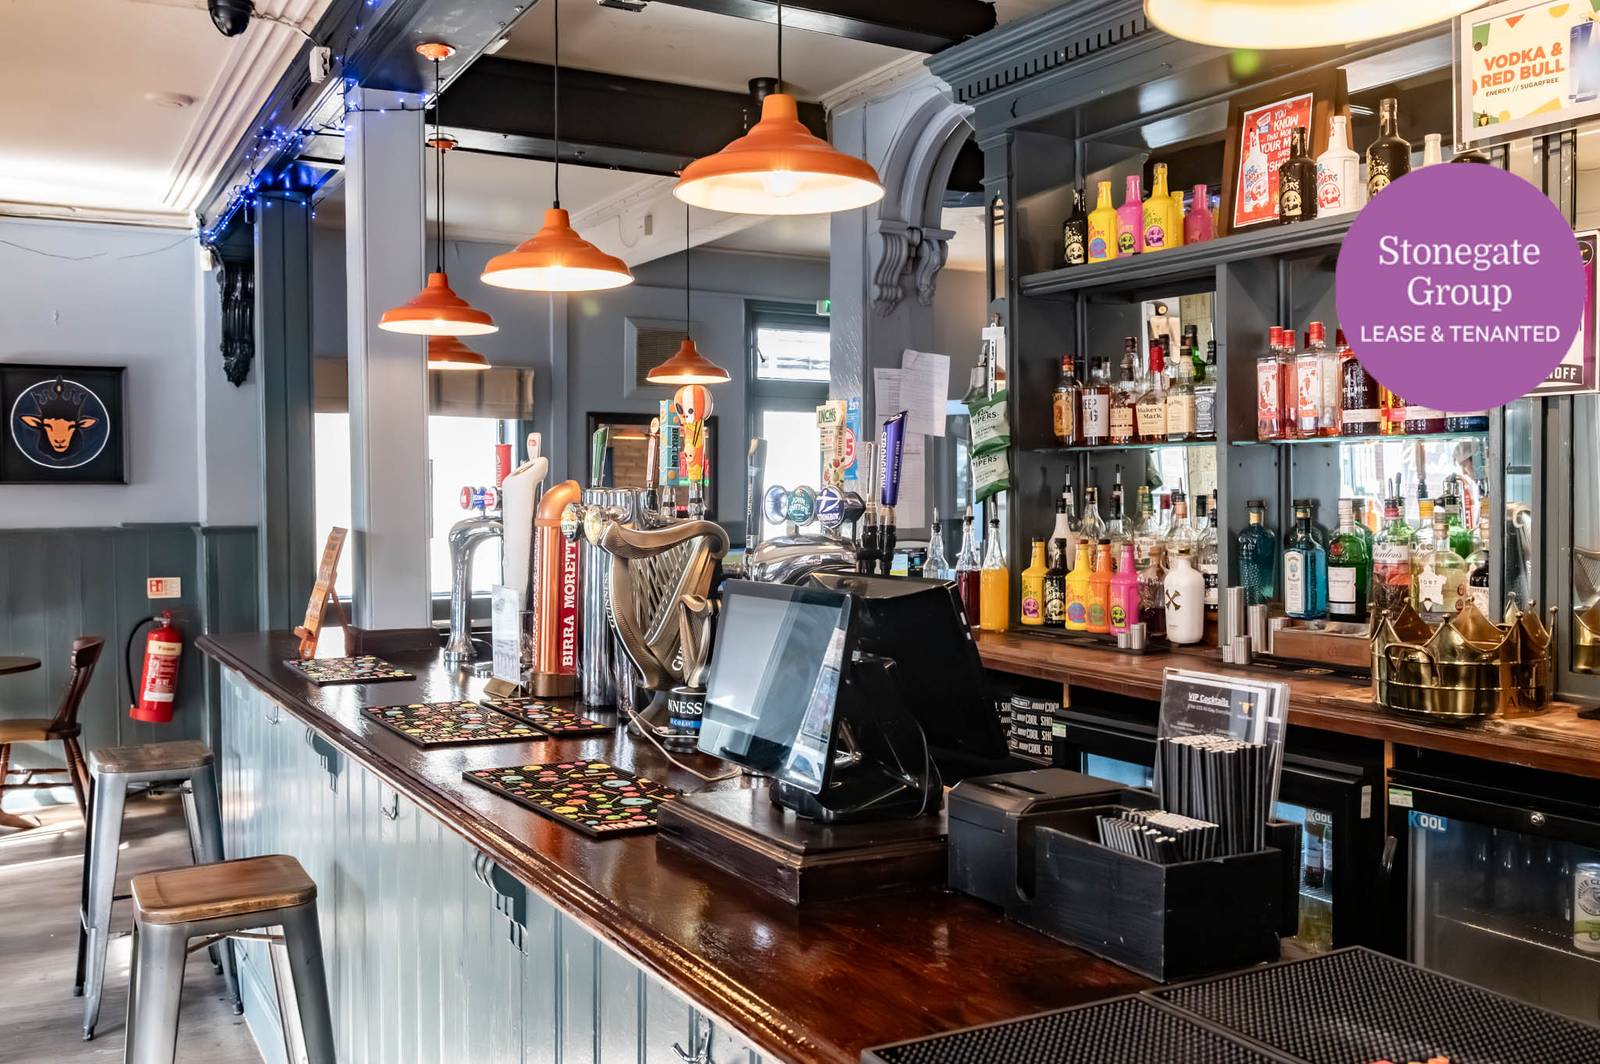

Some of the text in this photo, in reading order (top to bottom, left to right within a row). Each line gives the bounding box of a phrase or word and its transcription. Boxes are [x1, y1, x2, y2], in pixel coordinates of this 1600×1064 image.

[1484, 42, 1562, 71] VODKA &
[1481, 59, 1565, 88] RED BULL
[1486, 87, 1510, 97] ENERGY
[1520, 77, 1559, 90] SUGARFREE
[1273, 115, 1299, 131] KNOW
[1274, 109, 1287, 120] YOU
[1260, 141, 1281, 153] YOUR
[671, 427, 680, 468] BRIXTON
[563, 539, 576, 609] MORETT
[603, 572, 617, 629] GUINNESS
[562, 614, 575, 667] BIRRA
[668, 699, 703, 715] NNESS
